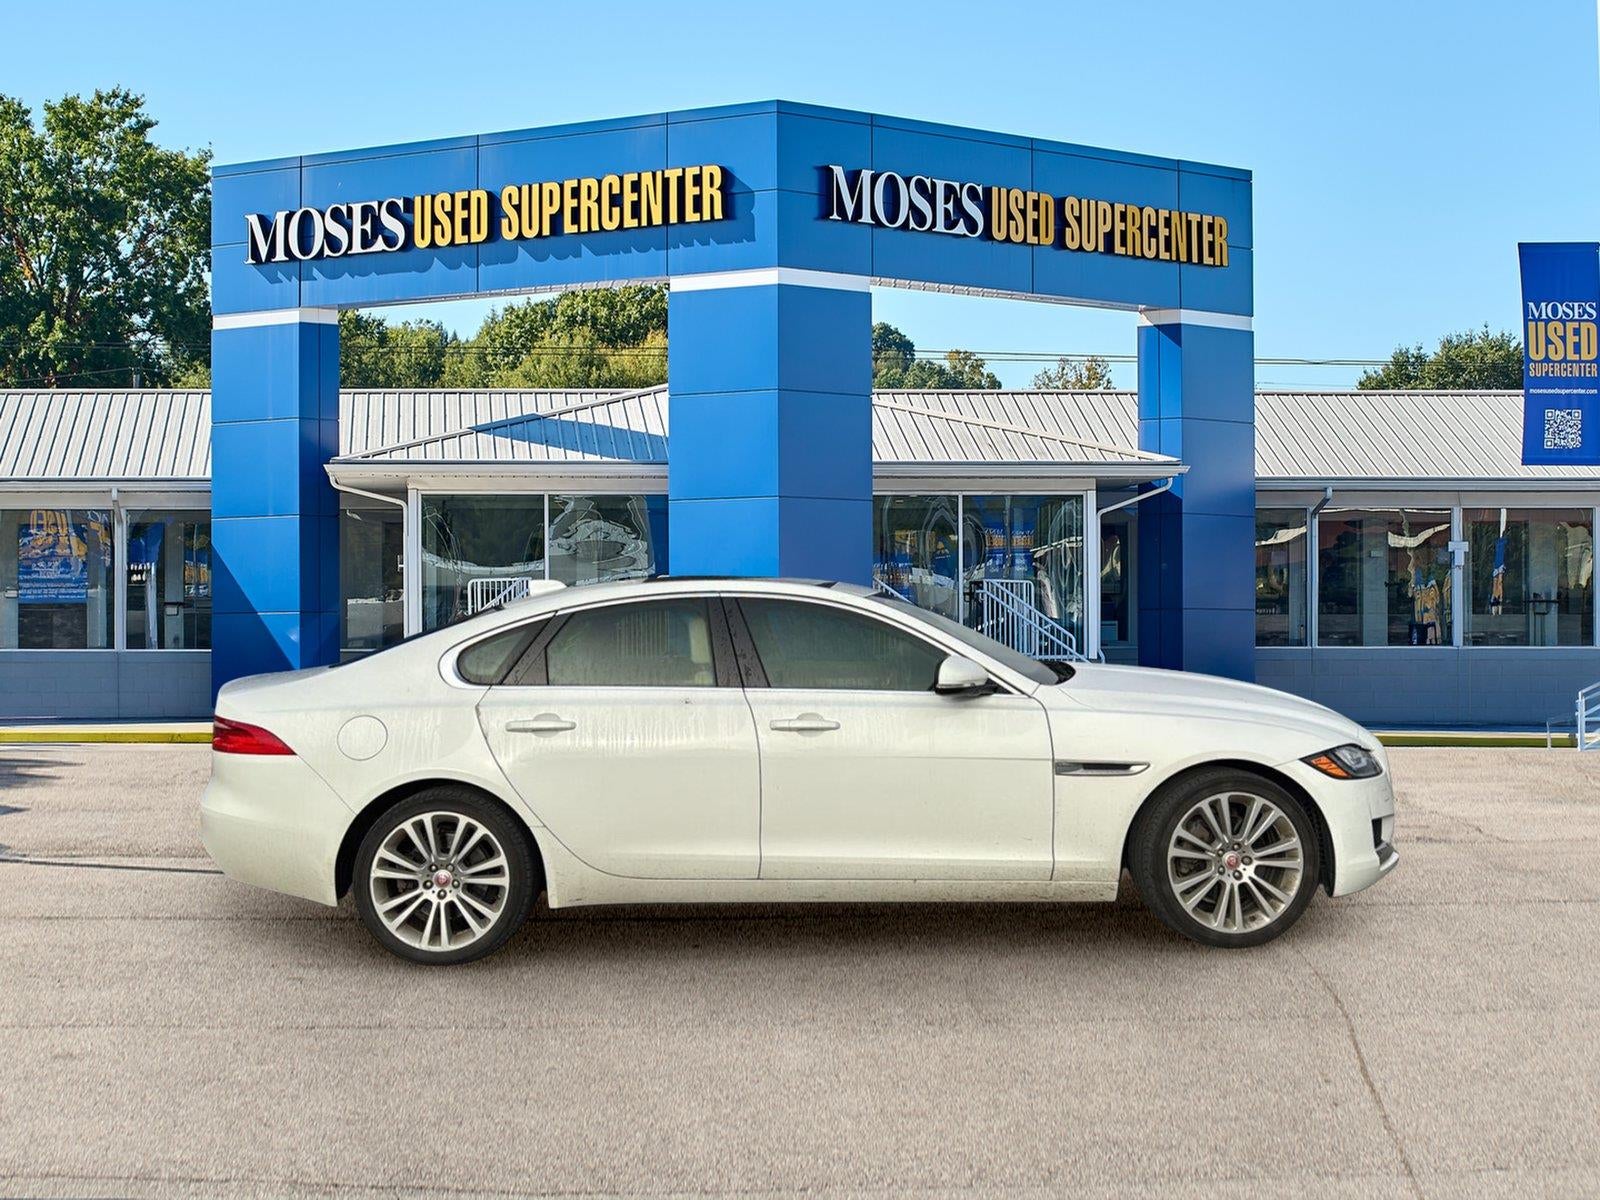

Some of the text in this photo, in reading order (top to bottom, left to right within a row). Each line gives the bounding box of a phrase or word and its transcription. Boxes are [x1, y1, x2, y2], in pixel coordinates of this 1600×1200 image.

[245, 165, 723, 265] MOSES USED SUPERCENTER
[828, 164, 1230, 267] MOSES USED SUPERCENTER
[1528, 302, 1597, 320] MOSES
[1528, 321, 1597, 361] USED
[1529, 362, 1597, 377] SUPERCENTER
